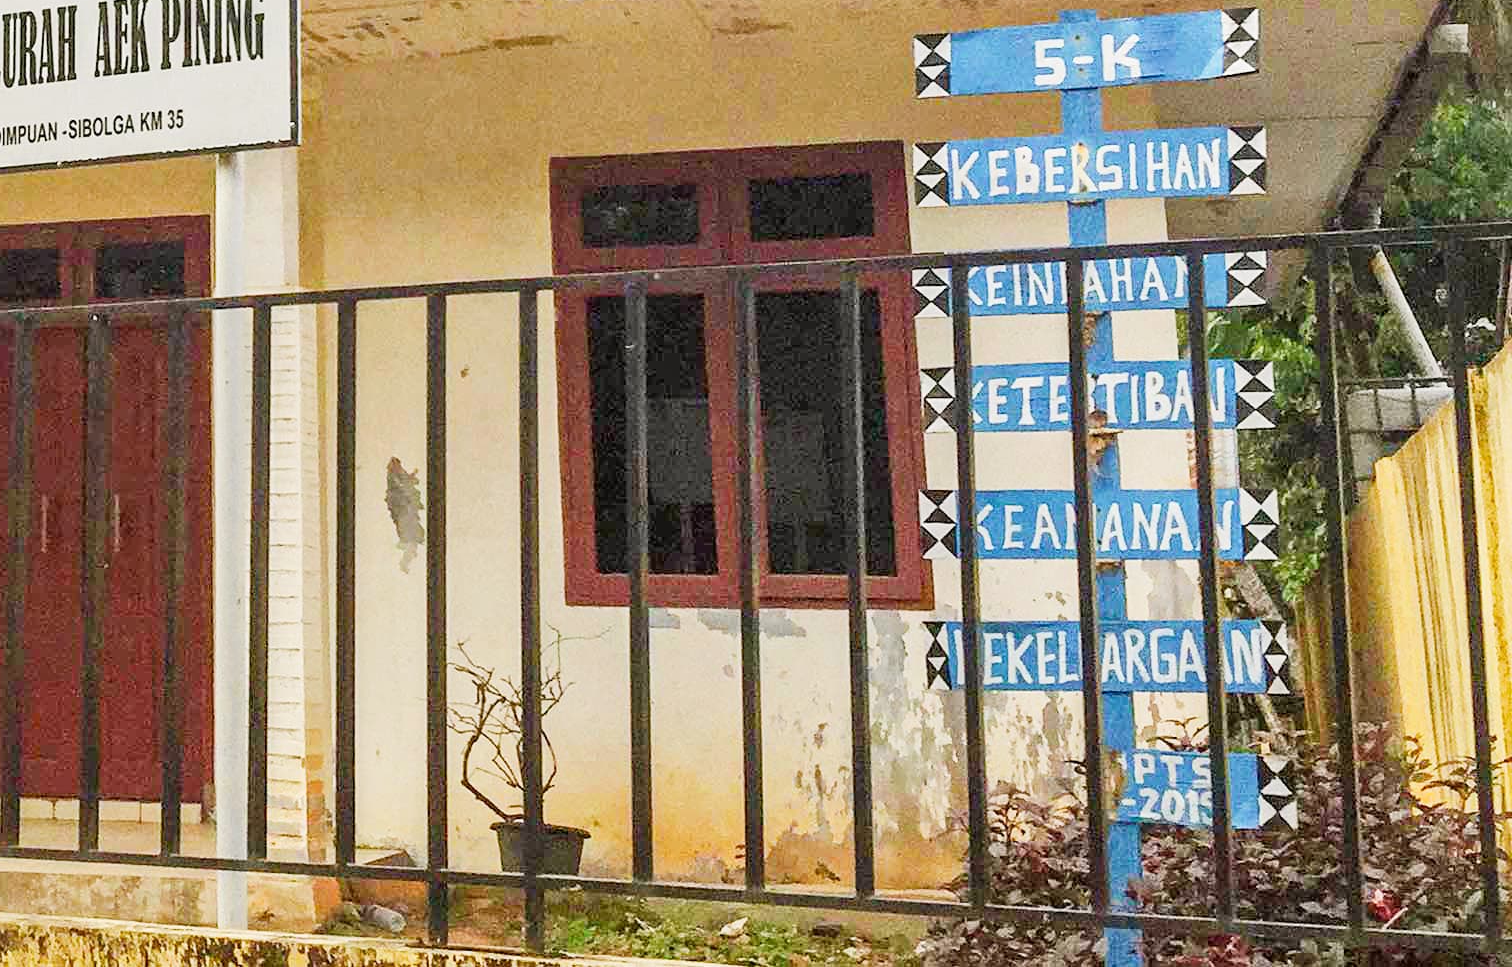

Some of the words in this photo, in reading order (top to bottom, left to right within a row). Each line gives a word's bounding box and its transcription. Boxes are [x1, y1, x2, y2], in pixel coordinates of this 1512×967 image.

[1033, 34, 1141, 86] 5-K
[141, 111, 162, 131] KM
[168, 109, 183, 129] 35
[950, 139, 1221, 199] KEBERSIHAN
[967, 256, 1189, 305] KEINAHA
[955, 628, 1266, 685] EKELARGAN
